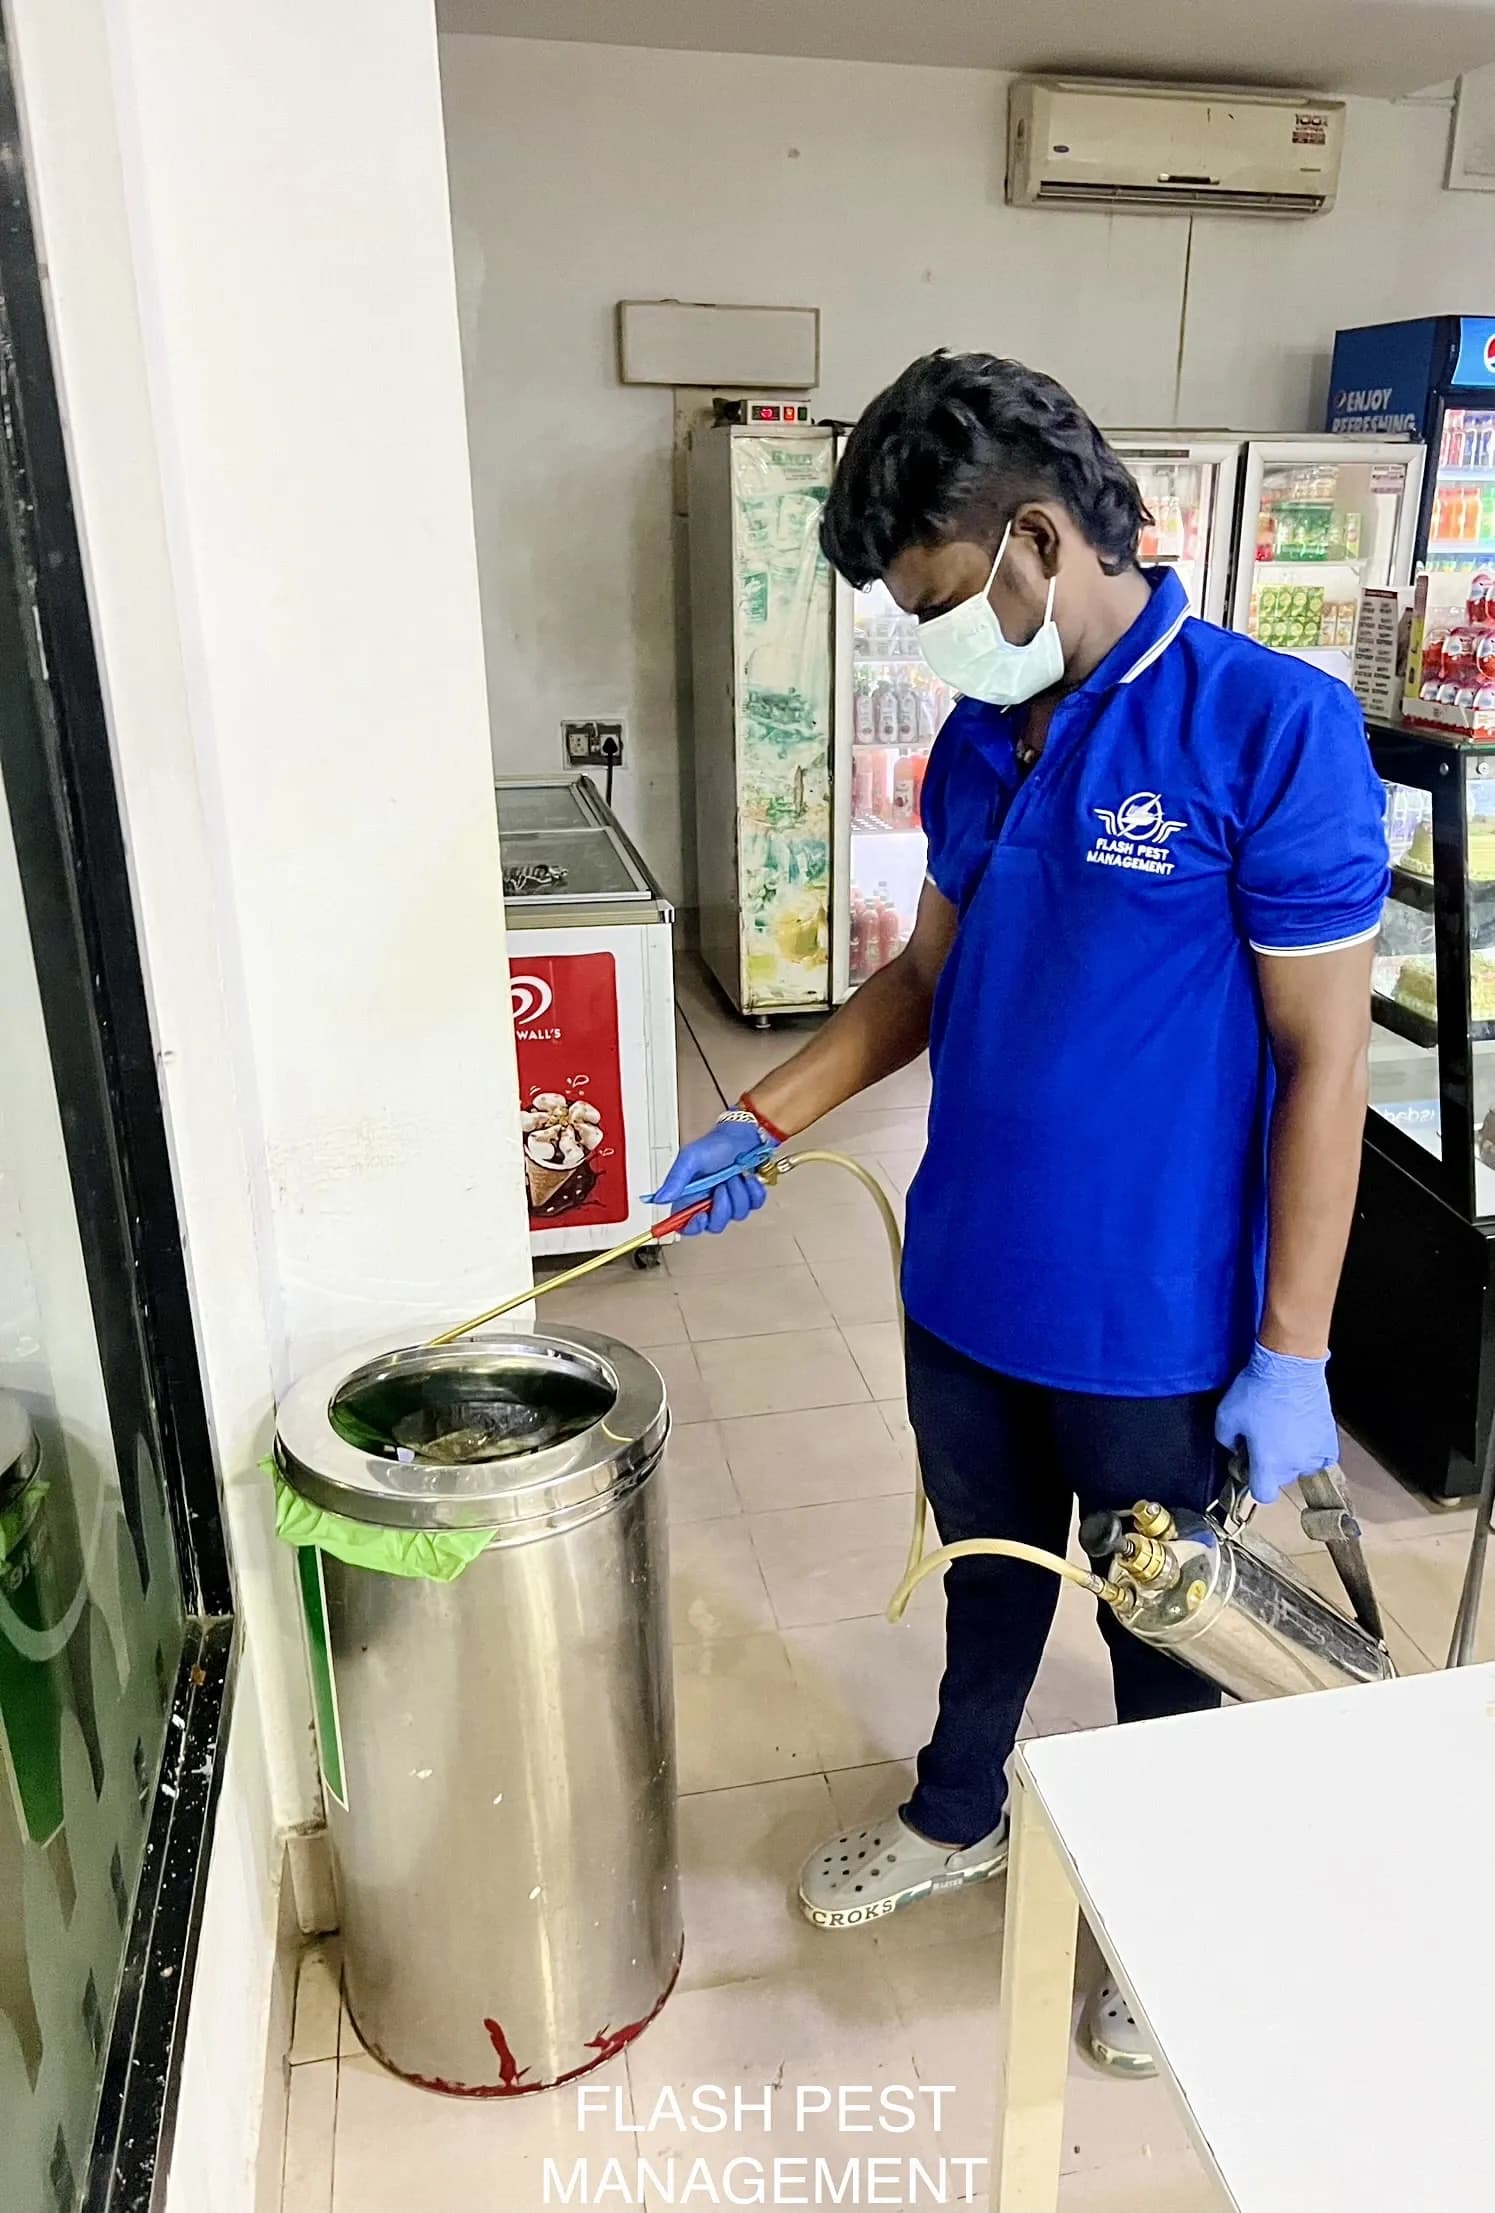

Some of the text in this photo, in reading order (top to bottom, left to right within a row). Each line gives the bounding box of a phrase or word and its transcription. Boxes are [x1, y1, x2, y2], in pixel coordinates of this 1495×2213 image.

[1346, 388, 1393, 412] ENJOY
[1096, 838, 1169, 861] FLASH PEST
[1087, 850, 1175, 876] MANAGEMENT
[516, 1028, 561, 1040] WALL'S
[813, 1900, 893, 1926] CROKS
